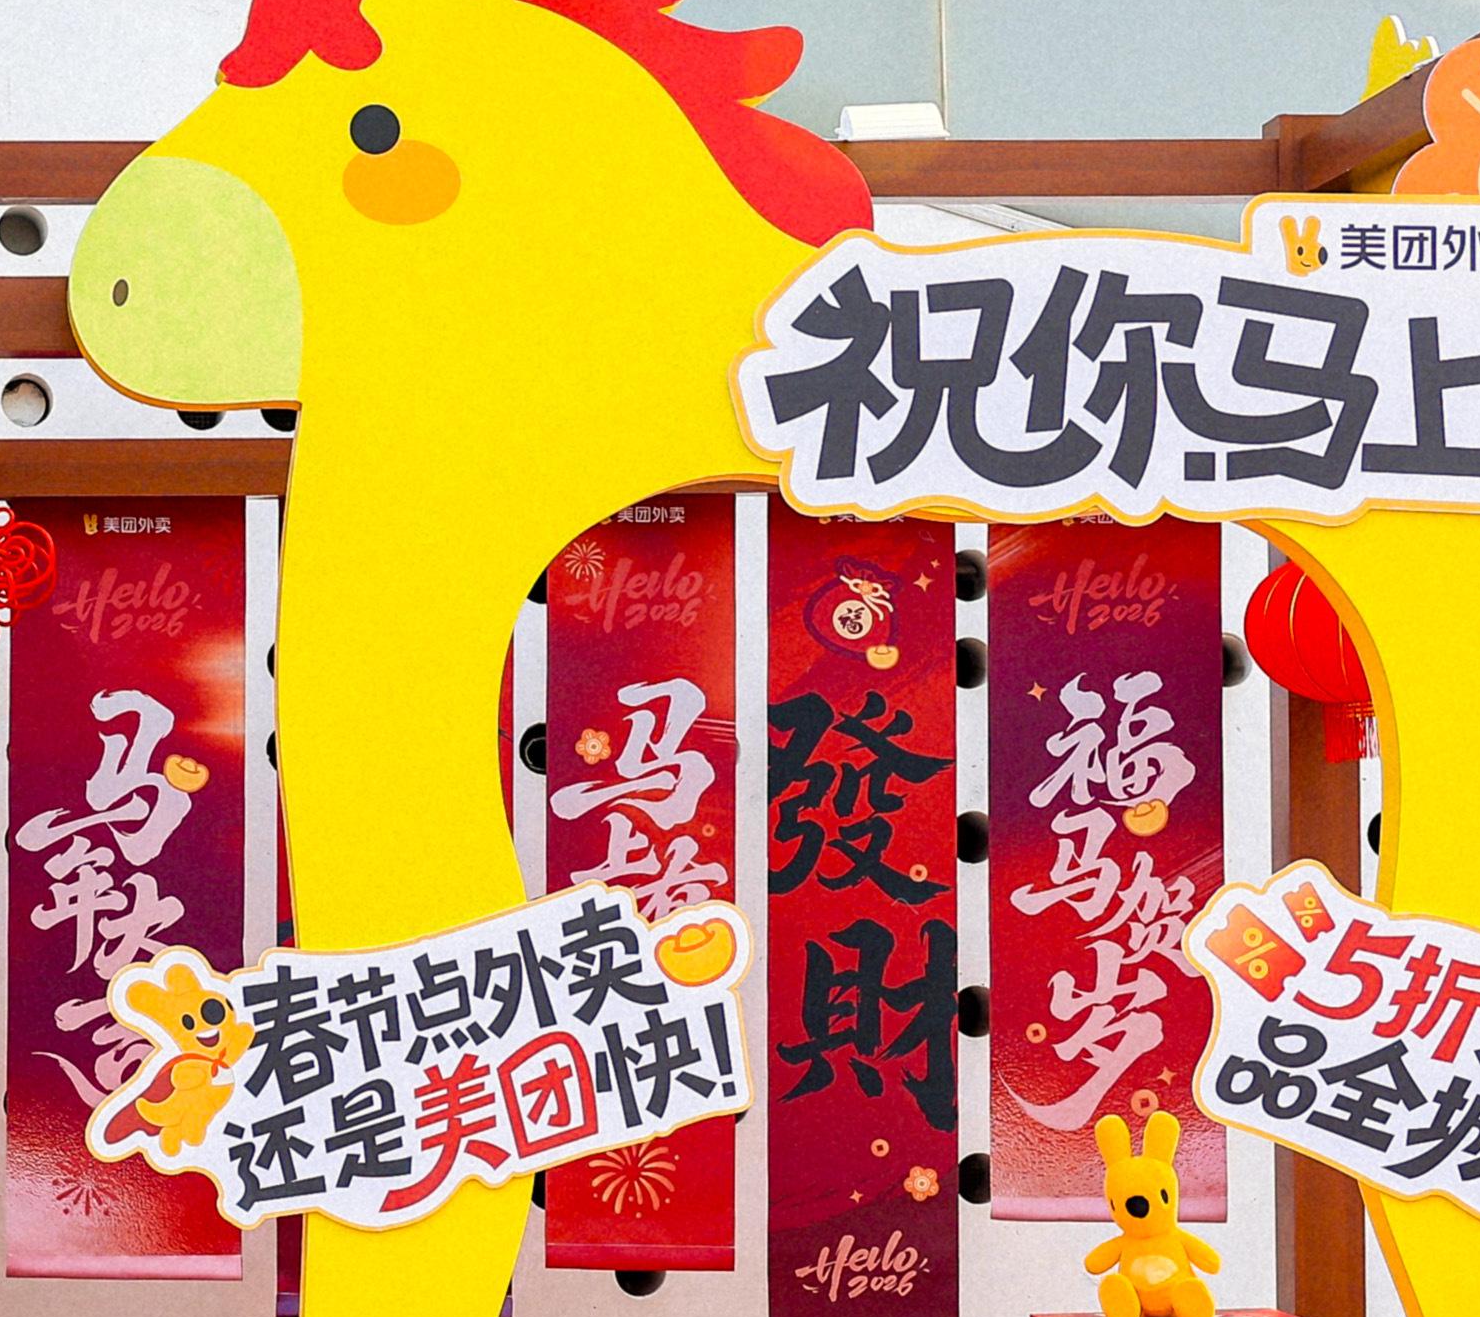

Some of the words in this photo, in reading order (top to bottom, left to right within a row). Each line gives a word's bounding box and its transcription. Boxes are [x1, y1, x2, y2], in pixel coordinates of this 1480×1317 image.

[102, 515, 172, 535] 美团外卖
[618, 505, 686, 524] 美团外卖
[110, 607, 186, 640] 2026
[1093, 599, 1162, 631] 2026
[241, 897, 668, 1106] 春节点外卖
[224, 1003, 736, 1214] 还是美团快!
[847, 1267, 916, 1299] 2026
